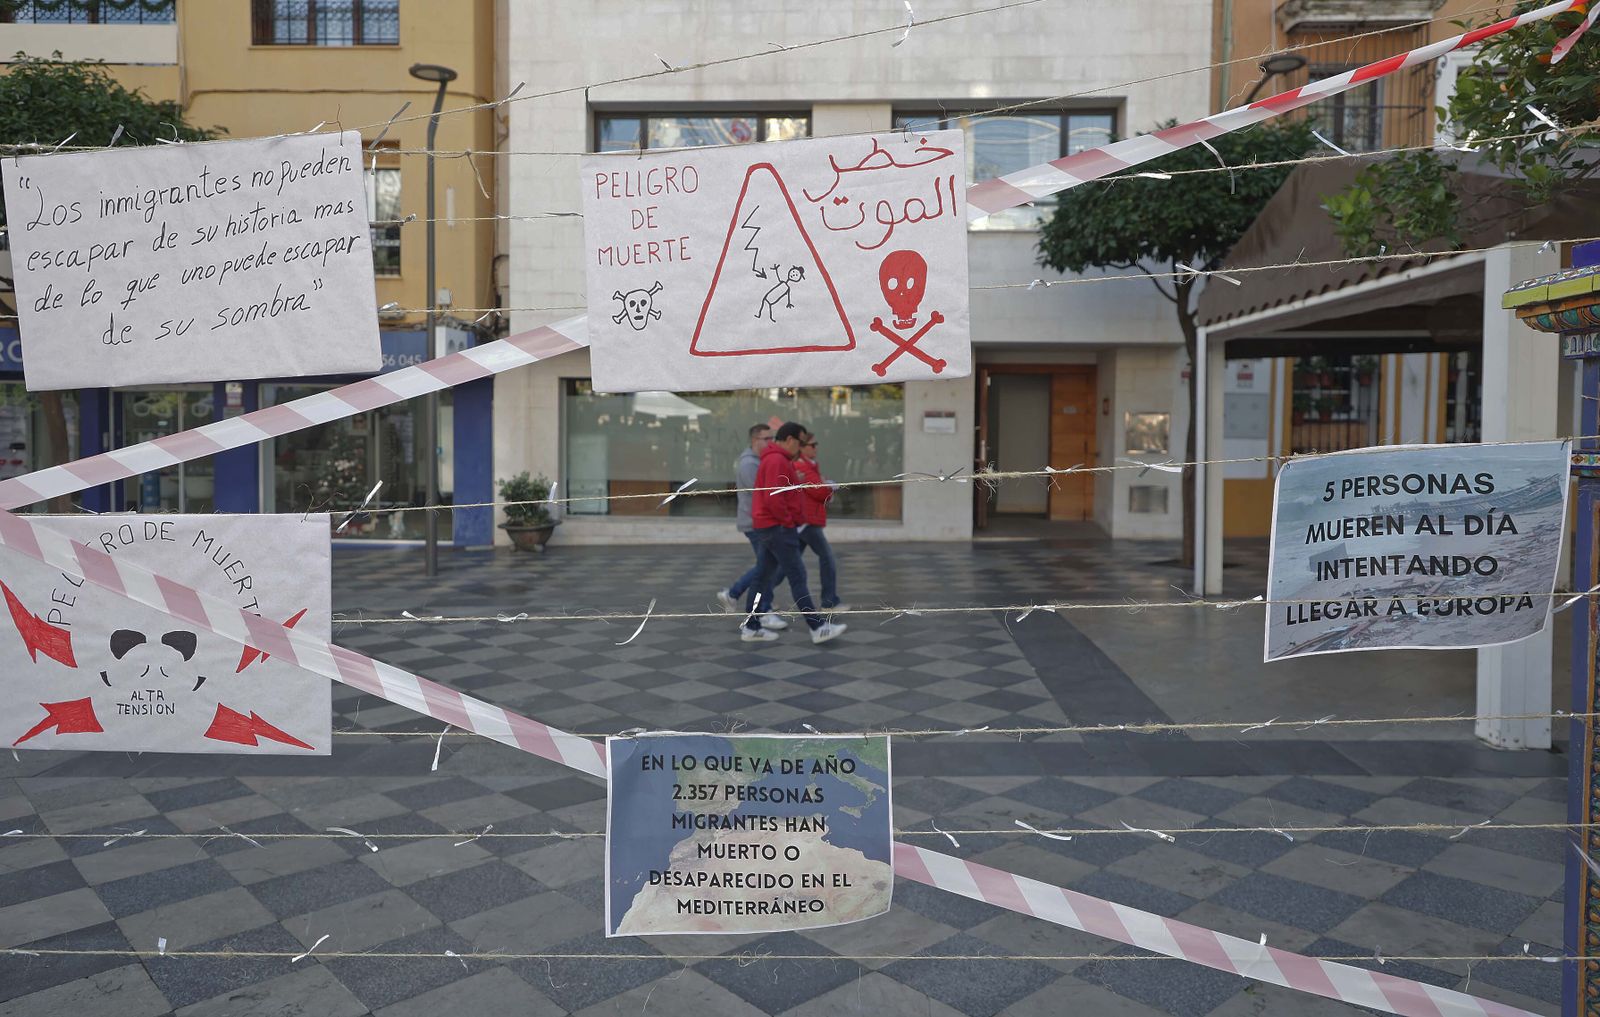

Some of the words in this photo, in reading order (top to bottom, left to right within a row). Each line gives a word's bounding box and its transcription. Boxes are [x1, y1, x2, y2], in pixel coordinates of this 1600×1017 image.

[595, 165, 699, 199] PELIGRO
[803, 138, 954, 202] خطر
[100, 166, 241, 222] inmigrantes
[251, 170, 274, 189] no
[632, 207, 659, 230] DE
[820, 174, 957, 250] الموت
[27, 240, 134, 272] escapar
[152, 222, 179, 251] de
[191, 225, 218, 246] su
[225, 202, 303, 235] historia
[313, 200, 354, 218] mas
[598, 236, 692, 266] MUERTE
[34, 285, 63, 312] de
[80, 280, 103, 307] lo
[121, 273, 160, 310] que
[182, 266, 216, 284] uno
[218, 242, 278, 285] puede
[283, 234, 361, 266] escapar
[103, 313, 132, 345] de
[155, 318, 195, 340] su
[1323, 481, 1335, 502] 5
[1341, 472, 1495, 499] PERSONAS
[1305, 514, 1404, 544] MUEREN
[1414, 514, 1453, 535] AL
[1464, 507, 1518, 535] DÍA
[48, 524, 134, 625] PELRO
[144, 521, 175, 541] DE
[191, 530, 261, 617] MUERT
[1317, 555, 1498, 581] INTENTANDO
[1287, 600, 1378, 625] LLEGAR
[1387, 598, 1407, 615] A
[1417, 592, 1534, 616] EUROPA
[117, 703, 175, 715] TENSION
[641, 754, 664, 771] EN
[672, 754, 697, 771] LO
[704, 755, 742, 773] QUE
[749, 757, 773, 774] VA
[781, 759, 804, 774] DE
[811, 755, 856, 775] AÑO
[672, 784, 717, 800] 2.357
[724, 786, 824, 804] PERSONAS
[672, 814, 778, 831] MIGRANTES
[785, 817, 826, 832] HAN
[698, 843, 777, 860] MUERTO
[784, 845, 800, 861] O
[649, 870, 794, 888] DESAPARECIDO
[801, 874, 824, 888] EN
[833, 873, 851, 887] EL
[677, 896, 825, 915] MEDITERRÁNEO
